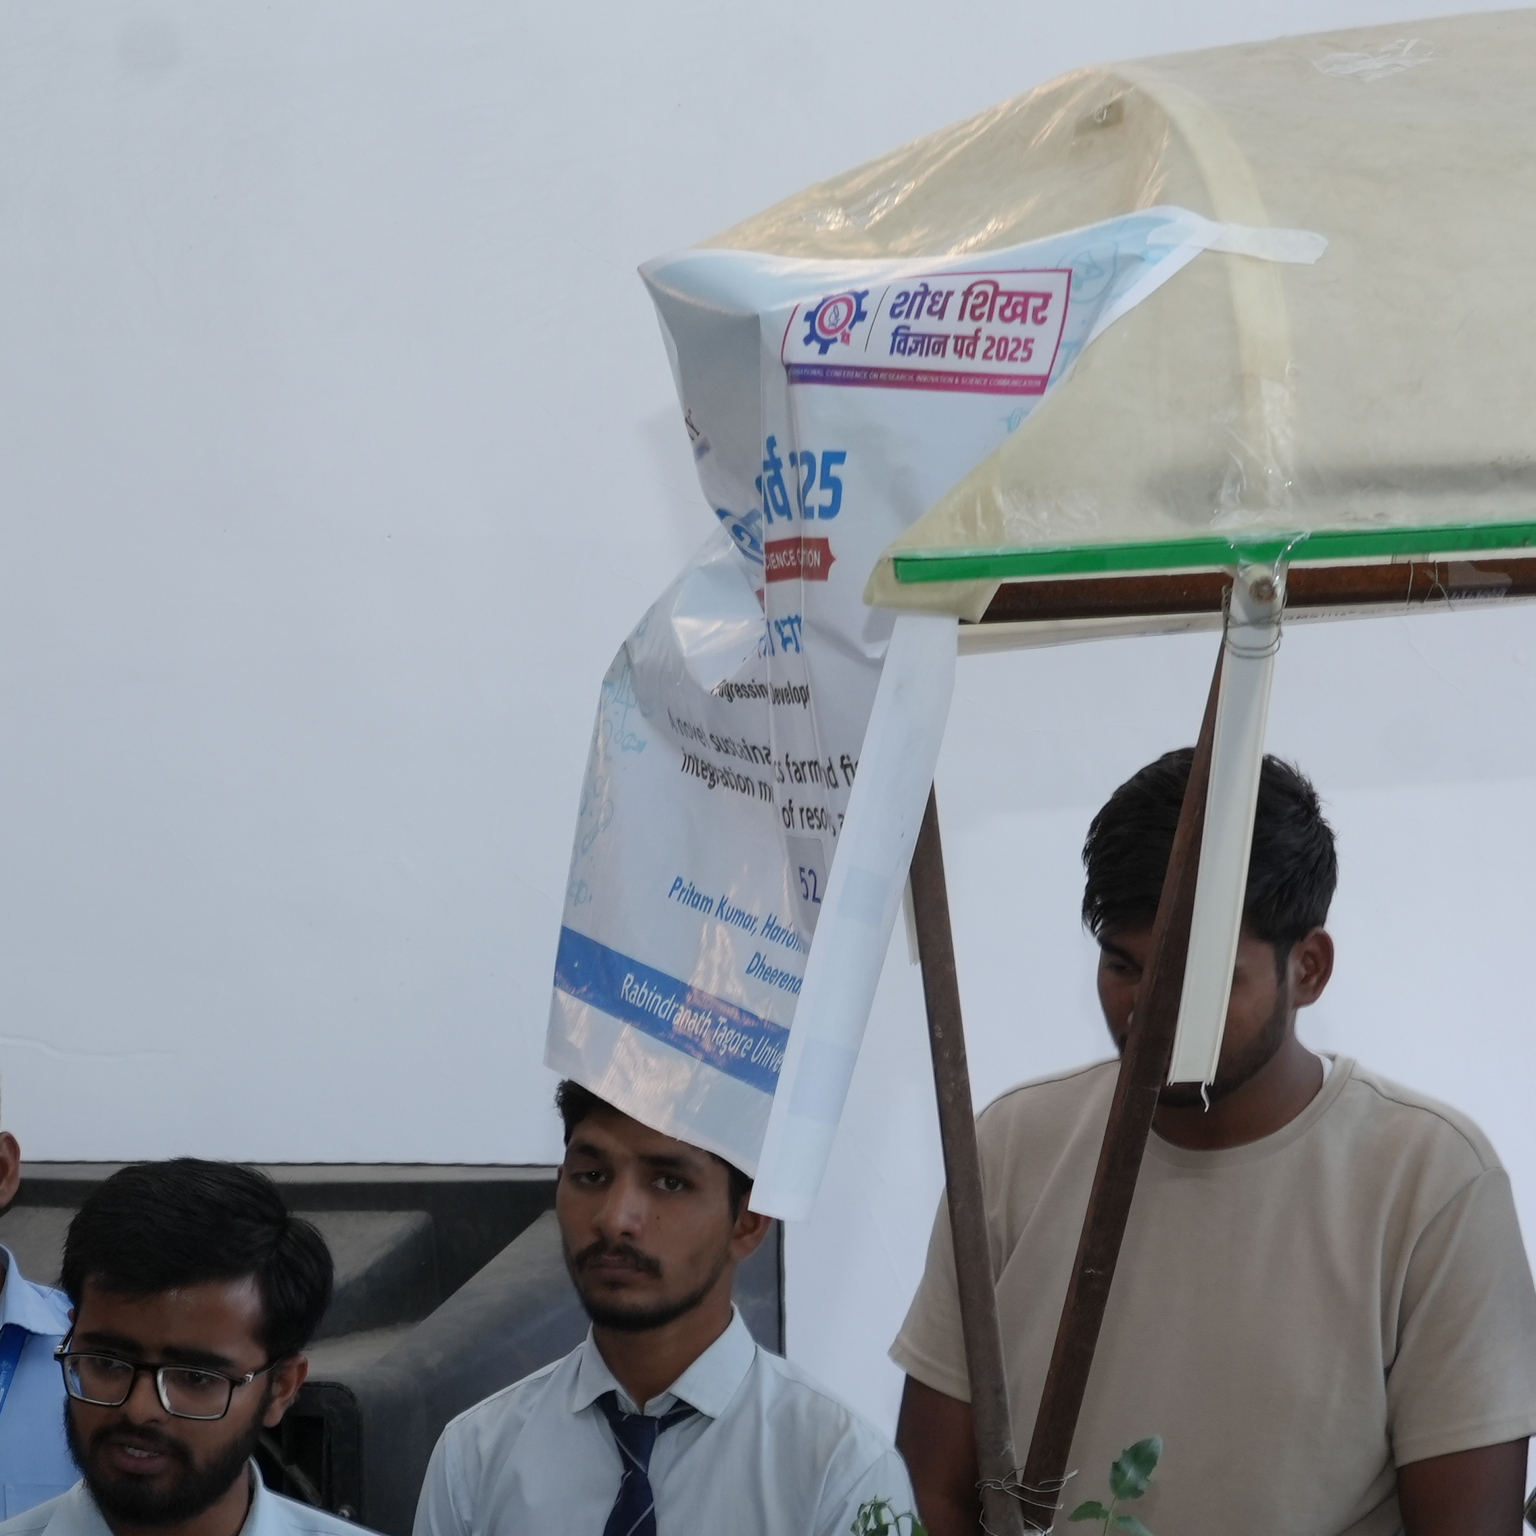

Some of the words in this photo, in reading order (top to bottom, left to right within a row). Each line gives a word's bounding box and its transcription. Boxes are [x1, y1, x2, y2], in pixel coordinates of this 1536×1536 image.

[889, 283, 955, 320] शोध
[957, 280, 1052, 325] शिखर
[889, 325, 950, 358] विज्ञान
[953, 328, 982, 360] पर्व
[982, 337, 1034, 362] 2025
[681, 746, 755, 798] integration
[781, 799, 795, 829] of
[668, 876, 714, 915] Pritam
[715, 895, 759, 937] Kumar,
[799, 866, 822, 904] 52
[620, 972, 713, 1038] Rabindranath
[713, 1016, 755, 1058] Tagore
